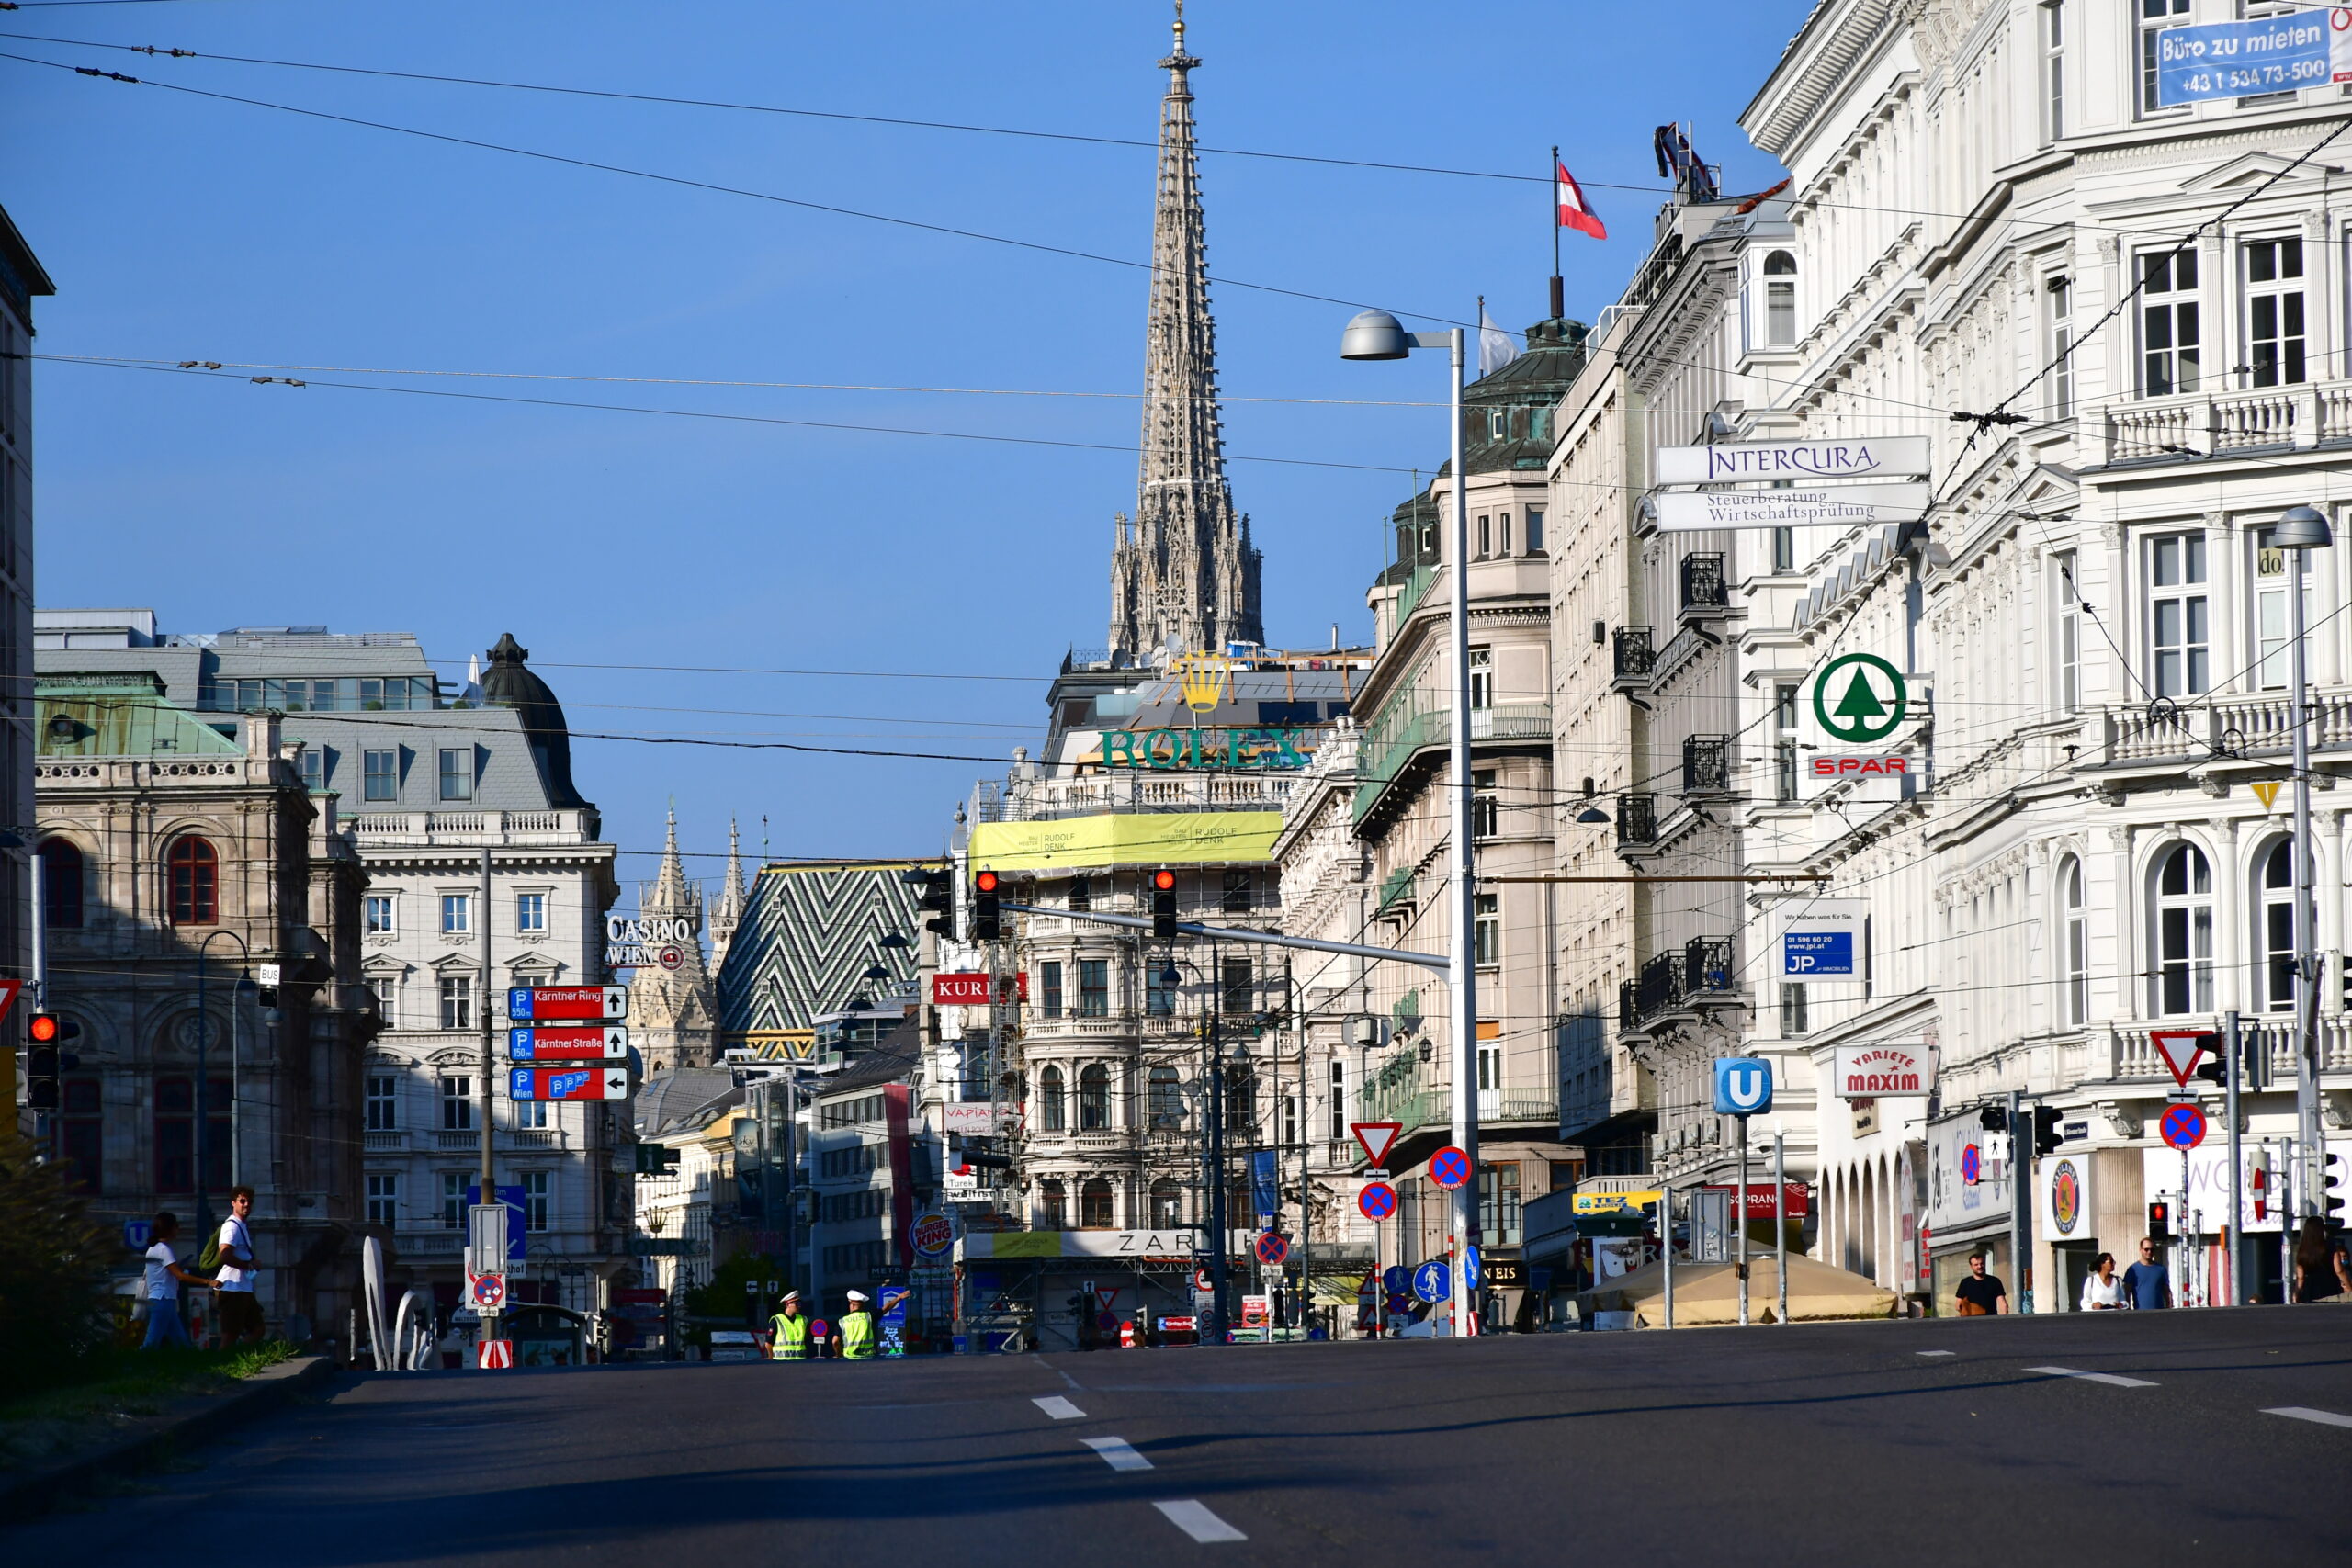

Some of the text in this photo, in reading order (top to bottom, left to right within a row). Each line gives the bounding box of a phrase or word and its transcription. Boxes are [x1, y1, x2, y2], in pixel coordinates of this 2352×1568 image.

[2162, 25, 2321, 62] Büro zu mieten
[2183, 59, 2325, 93] +43 1 534 73-500
[1706, 446, 1881, 479] INTERCURA
[1707, 491, 1828, 506] Steuerberatung
[1709, 503, 1876, 523] Wirtschaftsprüfung
[1098, 728, 1311, 768] ROLEX
[1814, 758, 1906, 774] SPAR
[1044, 832, 1075, 842] RUDOLF
[1195, 827, 1237, 837] RUDOLF
[1195, 836, 1224, 844] DENK
[1044, 842, 1066, 851] DENK
[606, 916, 689, 942] CASINO
[607, 946, 655, 964] WIEN
[1788, 955, 1815, 972] JP
[261, 968, 279, 981] BUS
[534, 991, 577, 1001] Kärntner
[578, 990, 602, 1003] Ring
[534, 1039, 573, 1048] Kärntner
[573, 1038, 603, 1047] Straße
[1851, 1050, 1916, 1068] VARIETE
[1729, 1070, 1762, 1107] U
[1847, 1073, 1919, 1091] MAXIM
[513, 1089, 533, 1099] Wien
[1438, 1181, 1463, 1190] ANFANG
[914, 1219, 950, 1236] BURGER
[916, 1227, 953, 1249] KING
[1495, 1268, 1516, 1279] EIS
